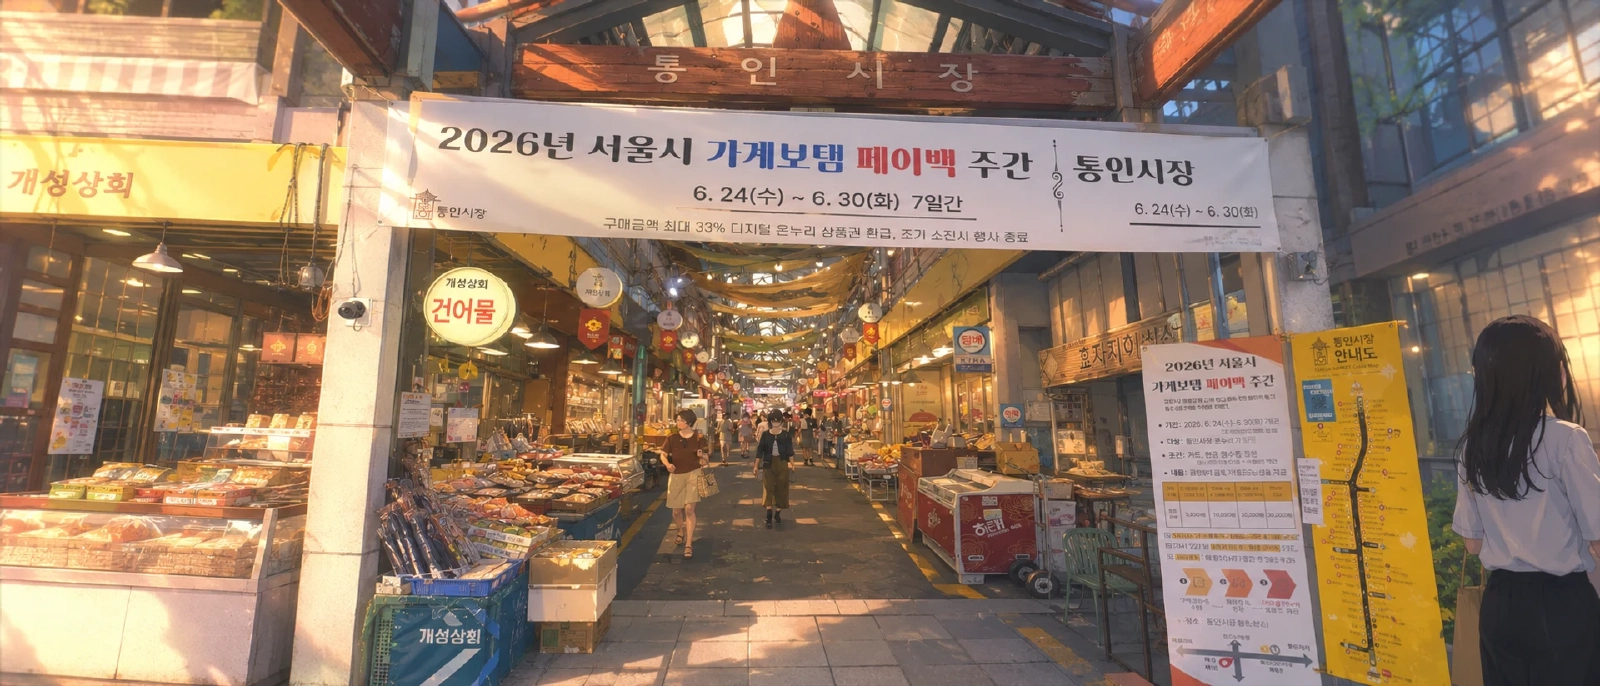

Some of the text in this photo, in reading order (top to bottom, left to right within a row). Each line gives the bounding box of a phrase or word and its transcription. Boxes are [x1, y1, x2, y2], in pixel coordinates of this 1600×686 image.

[437, 125, 576, 161] 2026년
[587, 133, 693, 166] 서울시
[856, 145, 957, 178] 페이백
[967, 149, 1034, 180] 주간
[1072, 153, 1196, 187] 통인시장
[6, 167, 135, 200] 개성상회
[693, 185, 714, 203] 6.
[719, 185, 784, 208] 24(수)
[811, 190, 832, 207] 6.
[838, 191, 901, 212] 30(화)
[911, 194, 964, 214] 7일간
[436, 205, 488, 220] 통인시장
[1134, 202, 1149, 216] 6.
[1151, 203, 1192, 218] 24(수)
[1206, 205, 1220, 218] 6.
[1222, 205, 1259, 219] 30(화)
[603, 216, 660, 232] 구매금액
[663, 219, 691, 234] 최대
[695, 221, 726, 234] 33%
[730, 221, 771, 236] 디지털
[775, 223, 816, 238] 온누리
[821, 226, 861, 240] 상품권
[900, 228, 926, 241] 조기
[930, 228, 969, 243] 소진시
[973, 230, 1001, 244] 행사
[1003, 231, 1029, 244] 종료
[445, 277, 489, 290] 개성상회
[431, 297, 497, 326] 건어물
[1333, 333, 1375, 348] 통인시장
[1164, 355, 1257, 373] 2026년 서울시
[1334, 347, 1378, 364] 안내도
[1249, 374, 1275, 388] 주간
